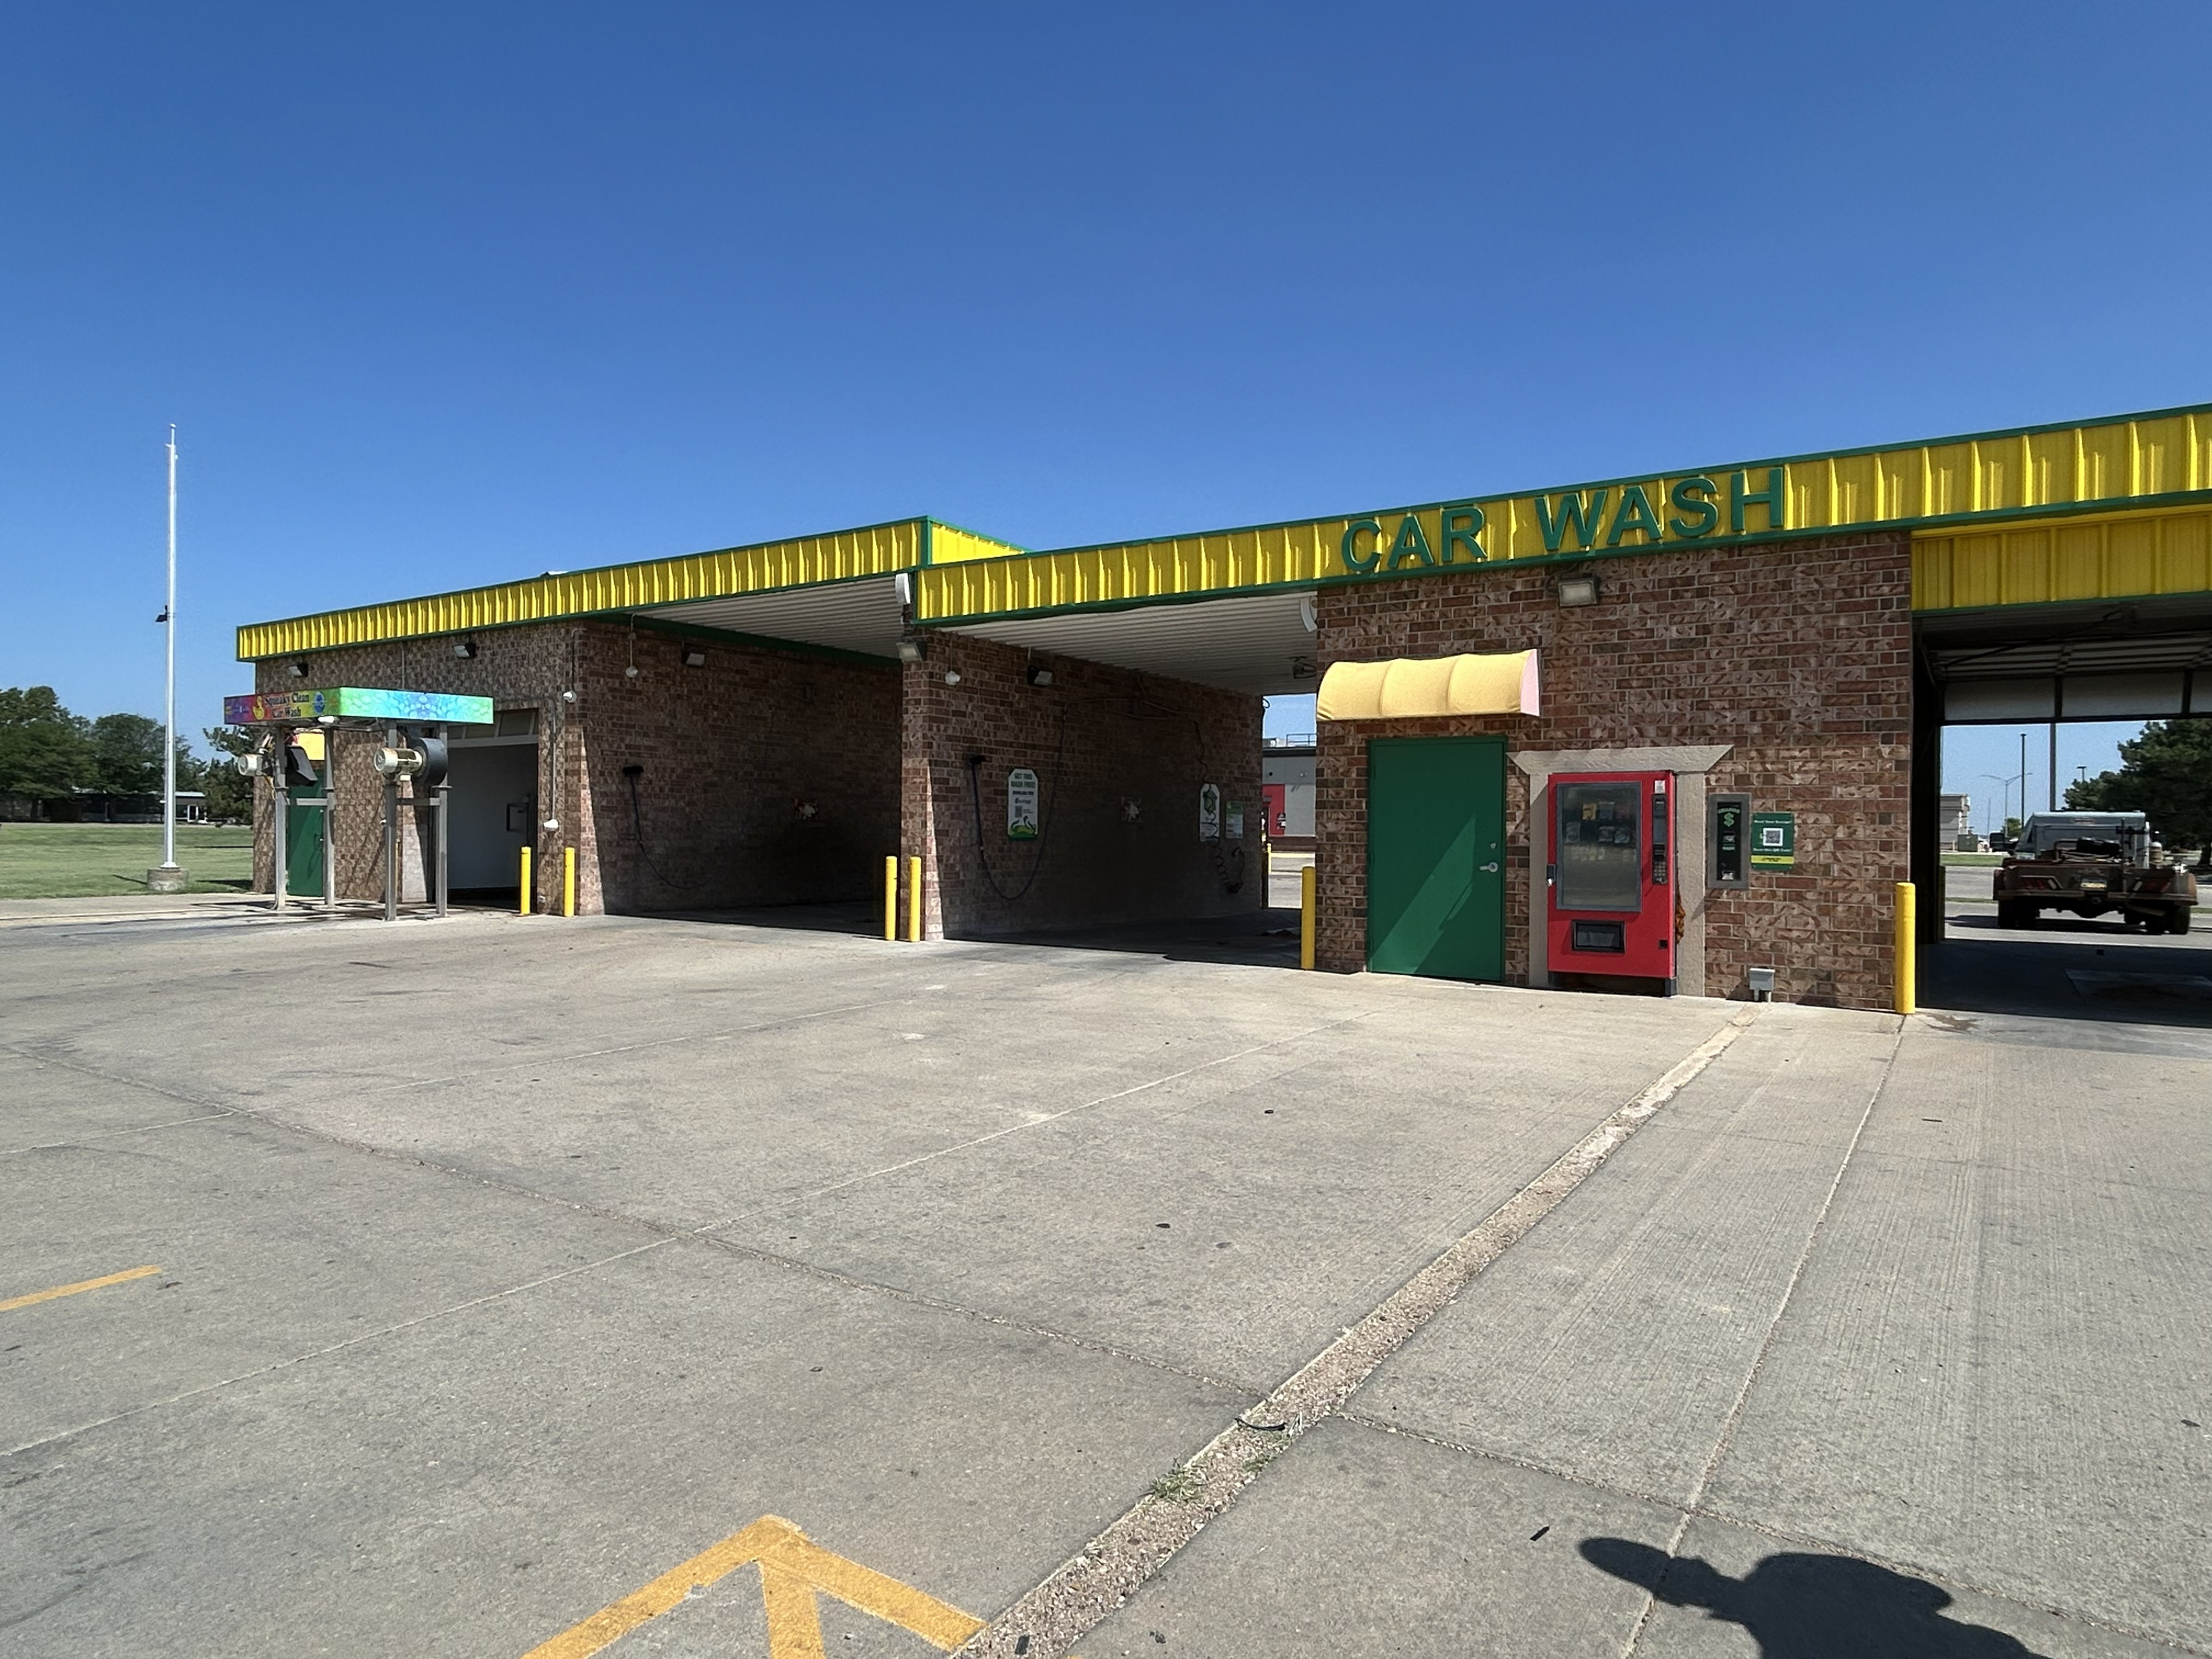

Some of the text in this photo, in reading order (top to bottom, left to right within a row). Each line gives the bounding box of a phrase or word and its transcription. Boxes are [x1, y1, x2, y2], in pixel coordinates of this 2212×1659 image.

[1341, 466, 1785, 572] CAR WASH
[292, 692, 309, 703] Clean
[1724, 812, 1735, 827] $
